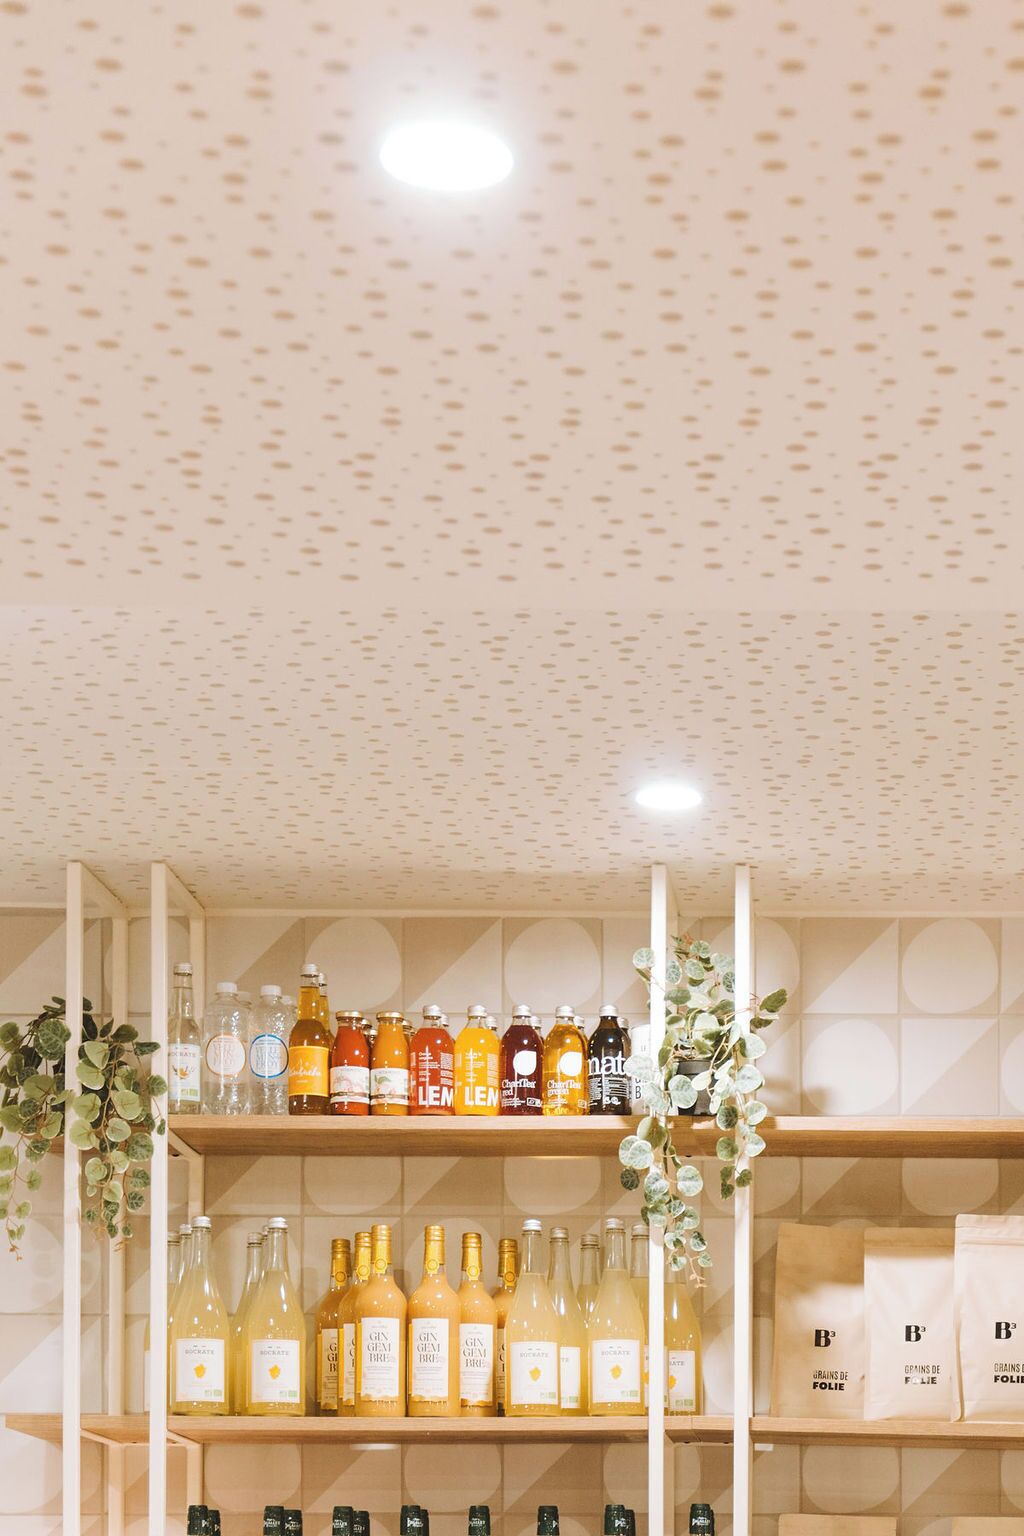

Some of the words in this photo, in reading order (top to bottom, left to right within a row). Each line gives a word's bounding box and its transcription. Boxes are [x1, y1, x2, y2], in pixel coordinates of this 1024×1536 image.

[369, 1332, 388, 1341] GIN
[418, 1332, 438, 1341] GIN
[367, 1342, 391, 1352] GEM
[465, 1338, 484, 1347] GIN
[416, 1343, 440, 1352] GEM
[462, 1348, 487, 1357] GEM
[905, 1365, 930, 1374] GRAINS
[932, 1365, 940, 1374] DE
[994, 1363, 1020, 1373] GRAINS
[813, 1370, 838, 1381] GRAINS
[839, 1370, 848, 1380] DE
[905, 1376, 937, 1384] FLIE
[812, 1382, 845, 1391] FOLIE
